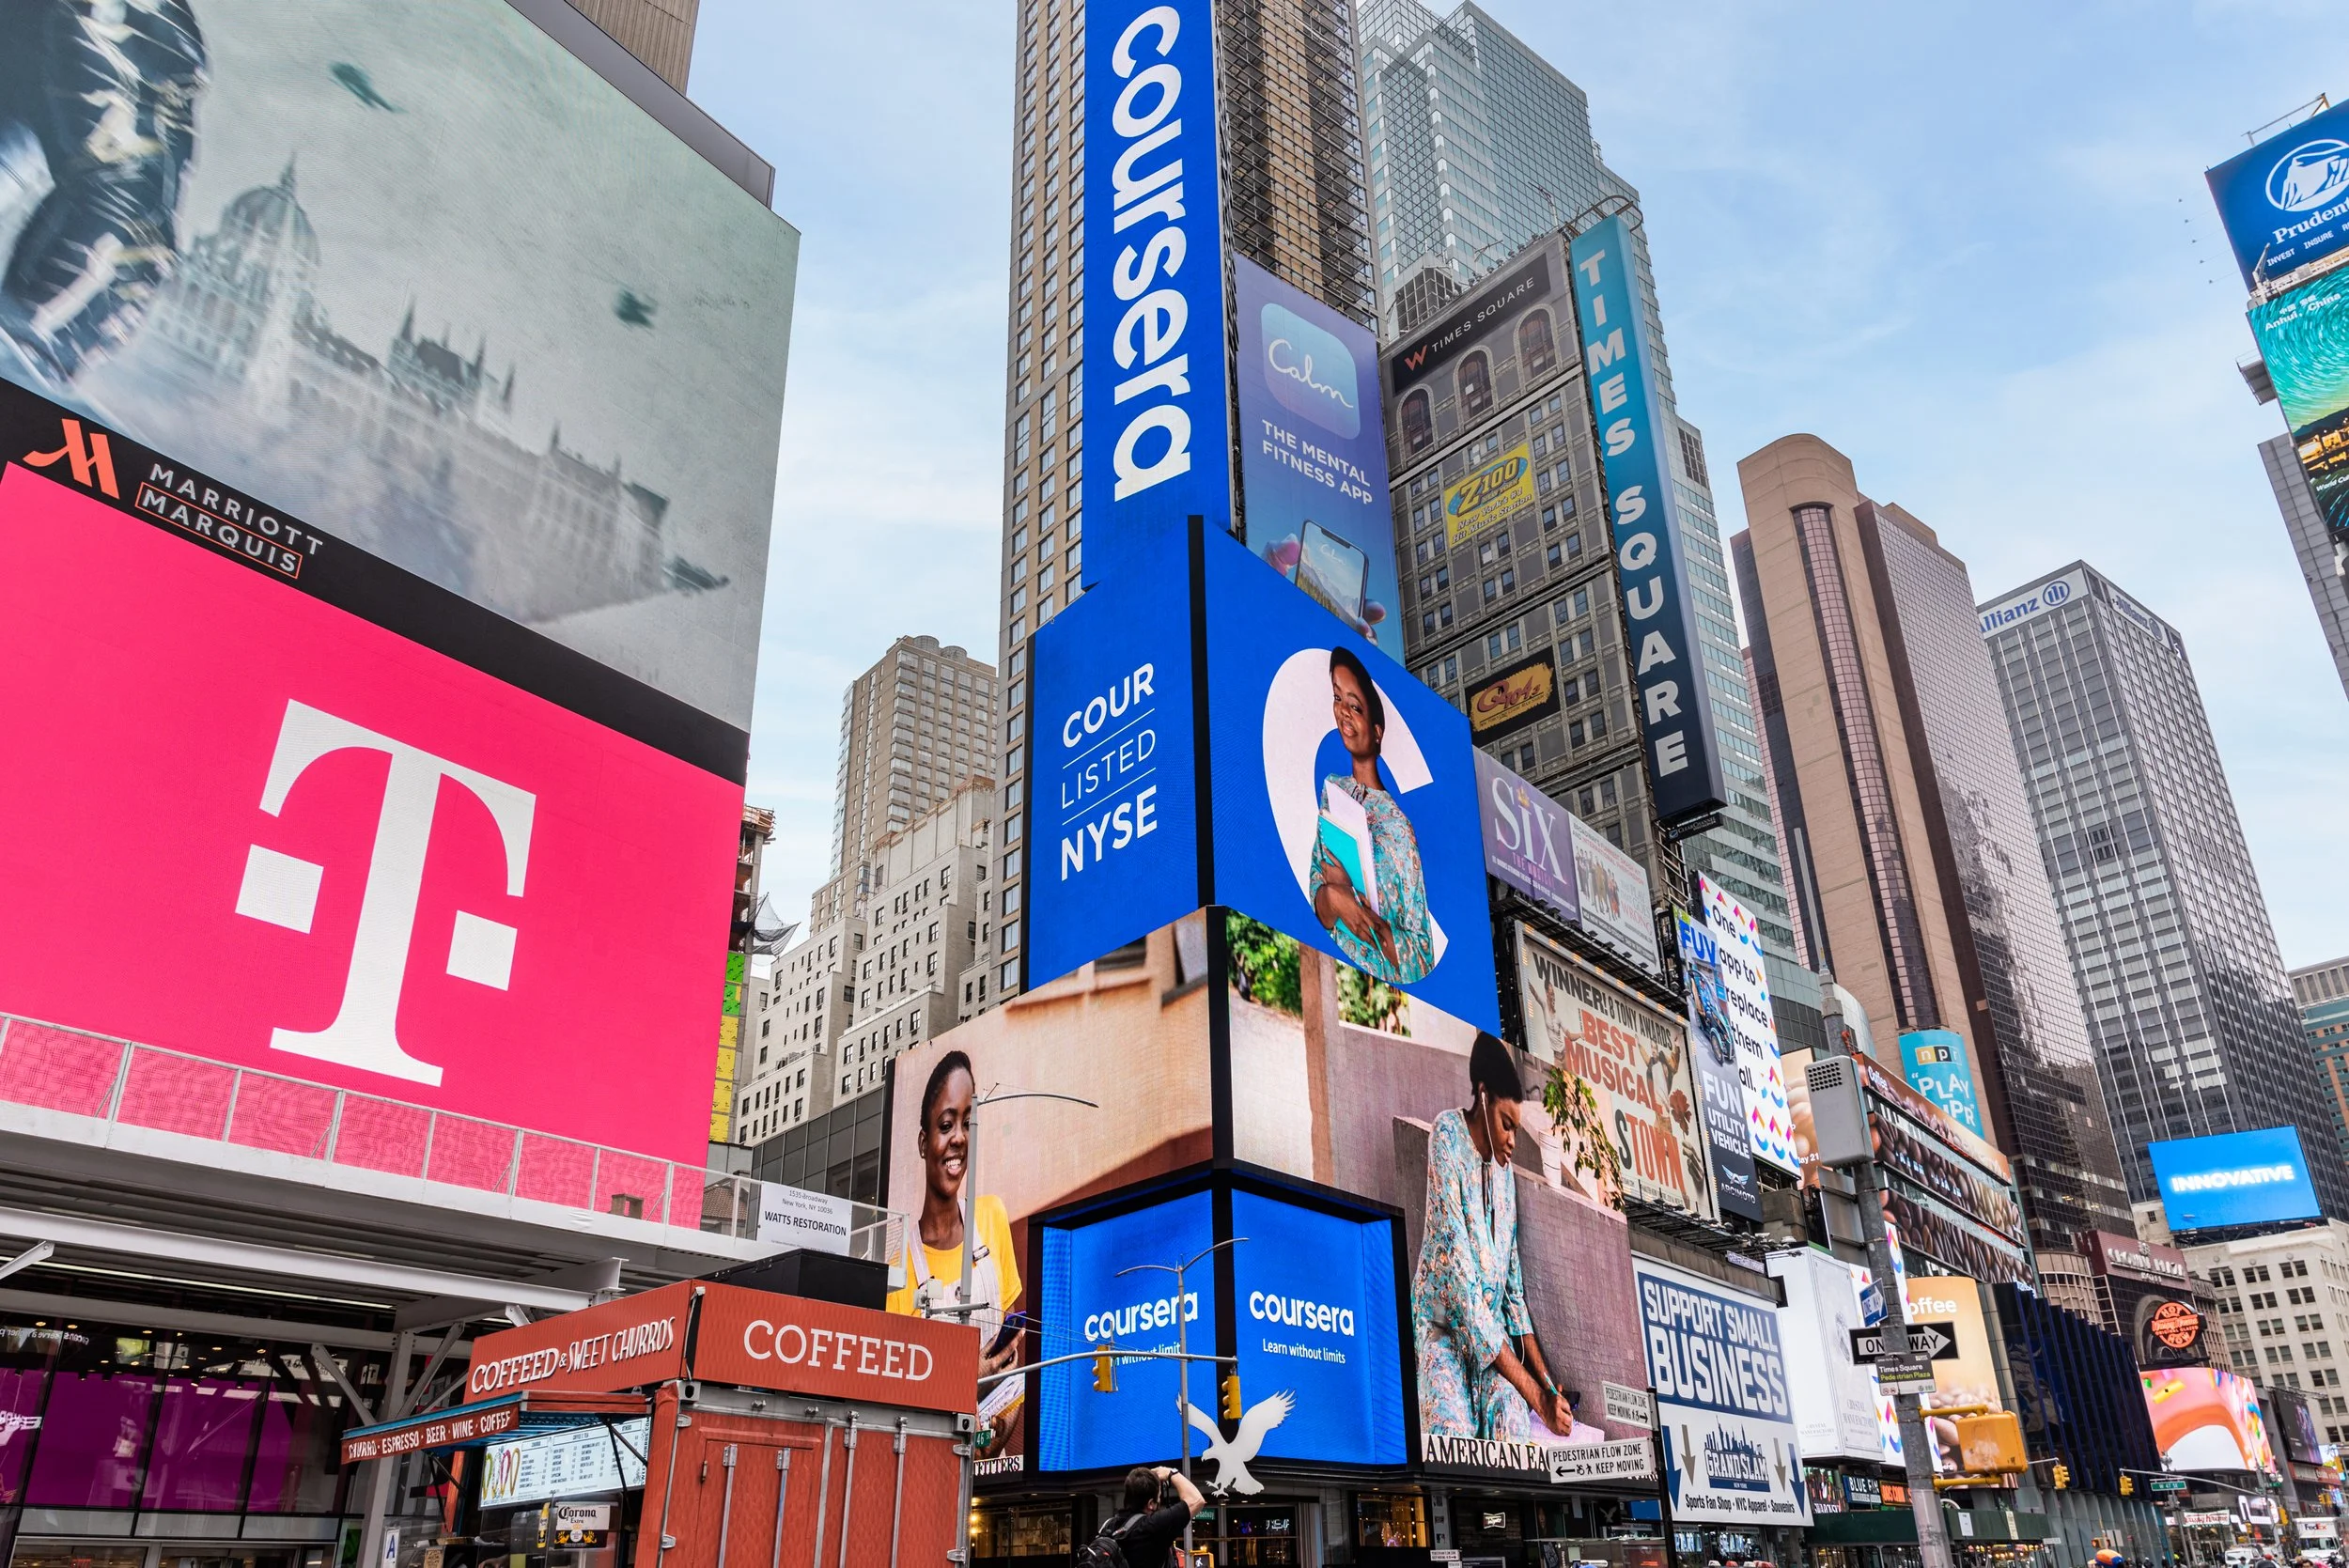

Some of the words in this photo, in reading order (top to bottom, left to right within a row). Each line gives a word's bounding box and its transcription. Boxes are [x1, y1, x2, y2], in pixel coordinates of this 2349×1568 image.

[1112, 5, 1192, 503] coursera
[2266, 248, 2295, 267] INVEST
[2303, 230, 2334, 250] INSURE
[2308, 293, 2341, 311] China
[1404, 345, 1428, 372] W
[1432, 321, 1471, 353] TIMES
[1477, 276, 1535, 323] SQUARE
[1579, 249, 1636, 457] TIMES
[1268, 338, 1354, 408] Calm
[1262, 420, 1297, 449] THE
[1302, 443, 1371, 488] MENTAL
[1262, 440, 1336, 488] FITNESS
[1341, 480, 1373, 505] APP
[1457, 457, 1519, 517] Z100
[2316, 480, 2337, 491] World
[149, 463, 323, 555] MARRIOTT
[1453, 530, 1468, 544] Hit
[1469, 515, 1498, 536] Music
[1499, 493, 1532, 519] Station
[1457, 514, 1480, 531] New
[142, 489, 296, 573] MARQUIS
[1616, 485, 1688, 778] SQUARE
[1063, 662, 1155, 749] COUR
[1061, 728, 1157, 810] LISTED
[1060, 784, 1159, 881] NYSE
[1492, 777, 1567, 885] SIX
[1712, 904, 1737, 939] One
[1678, 919, 1718, 968] FUV
[1719, 945, 1741, 978] app
[1742, 958, 1756, 986] to
[1532, 952, 1608, 1017] WINNER!
[1615, 999, 1638, 1032] TONY
[1639, 1013, 1673, 1051] AWARDS
[1725, 987, 1768, 1028] replace
[1581, 1009, 1637, 1066] BEST
[1731, 1024, 1764, 1061] them
[1921, 1047, 1959, 1061] npr
[1564, 1038, 1663, 1114] MUSICAL
[1703, 1069, 1743, 1118] FUN
[1739, 1066, 1757, 1092] all.
[1707, 1108, 1746, 1142] UTILITY
[1711, 1127, 1750, 1159] VEHICLE
[1615, 1109, 1688, 1198] STOWN
[1810, 1152, 1820, 1162] 21
[789, 1189, 802, 1199] 1535
[802, 1193, 829, 1204] Broadway
[1720, 1181, 1756, 1204] ARCIMOTO
[2171, 1165, 2295, 1192] INNOVATIVE
[782, 1198, 794, 1206] New
[764, 1210, 791, 1225] WATTS
[793, 1217, 847, 1236] RESTORATION
[1084, 1292, 1198, 1342] coursera
[1249, 1290, 1355, 1336] coursera
[1643, 1281, 1723, 1339] SUPPORT
[1724, 1304, 1779, 1353] SMALL
[1909, 1296, 1957, 1315] offee
[471, 1347, 559, 1394] COFFEED
[567, 1334, 612, 1373] SWEET
[612, 1316, 677, 1361] CHURROS
[743, 1319, 933, 1381] COFFEED
[1263, 1338, 1288, 1356] Learn
[1289, 1343, 1322, 1360] without
[1323, 1347, 1346, 1364] limits
[1865, 1336, 1885, 1353] ON
[1908, 1334, 1938, 1351] WAY
[1648, 1323, 1788, 1416] BUSINESS
[1879, 1365, 1898, 1374] Times
[1899, 1363, 1923, 1374] Square
[381, 1431, 420, 1454] ESPRESSO
[426, 1423, 446, 1446] BEER
[452, 1419, 474, 1440] WINE
[977, 1433, 985, 1445] 46
[1426, 1435, 1521, 1469] AMERICAN
[1525, 1445, 1550, 1472] EA
[1552, 1448, 1599, 1463] PEDESTRIAN
[1602, 1445, 1622, 1458] FLOW
[1624, 1443, 1642, 1456] ZONE
[1595, 1462, 1614, 1474] KEEP
[1616, 1458, 1644, 1472] MOVING
[1848, 1477, 1867, 1493] BLUE
[558, 1506, 598, 1521] Corona
[1195, 1510, 1215, 1520] roadway
[1685, 1494, 1705, 1511] Sports
[1705, 1496, 1718, 1509] Fan
[1718, 1496, 1732, 1513] Shop
[1735, 1498, 1748, 1511] NYC
[1748, 1498, 1767, 1514] Apparel
[1770, 1499, 1796, 1514] Souvenirs
[385, 1534, 396, 1560] A
